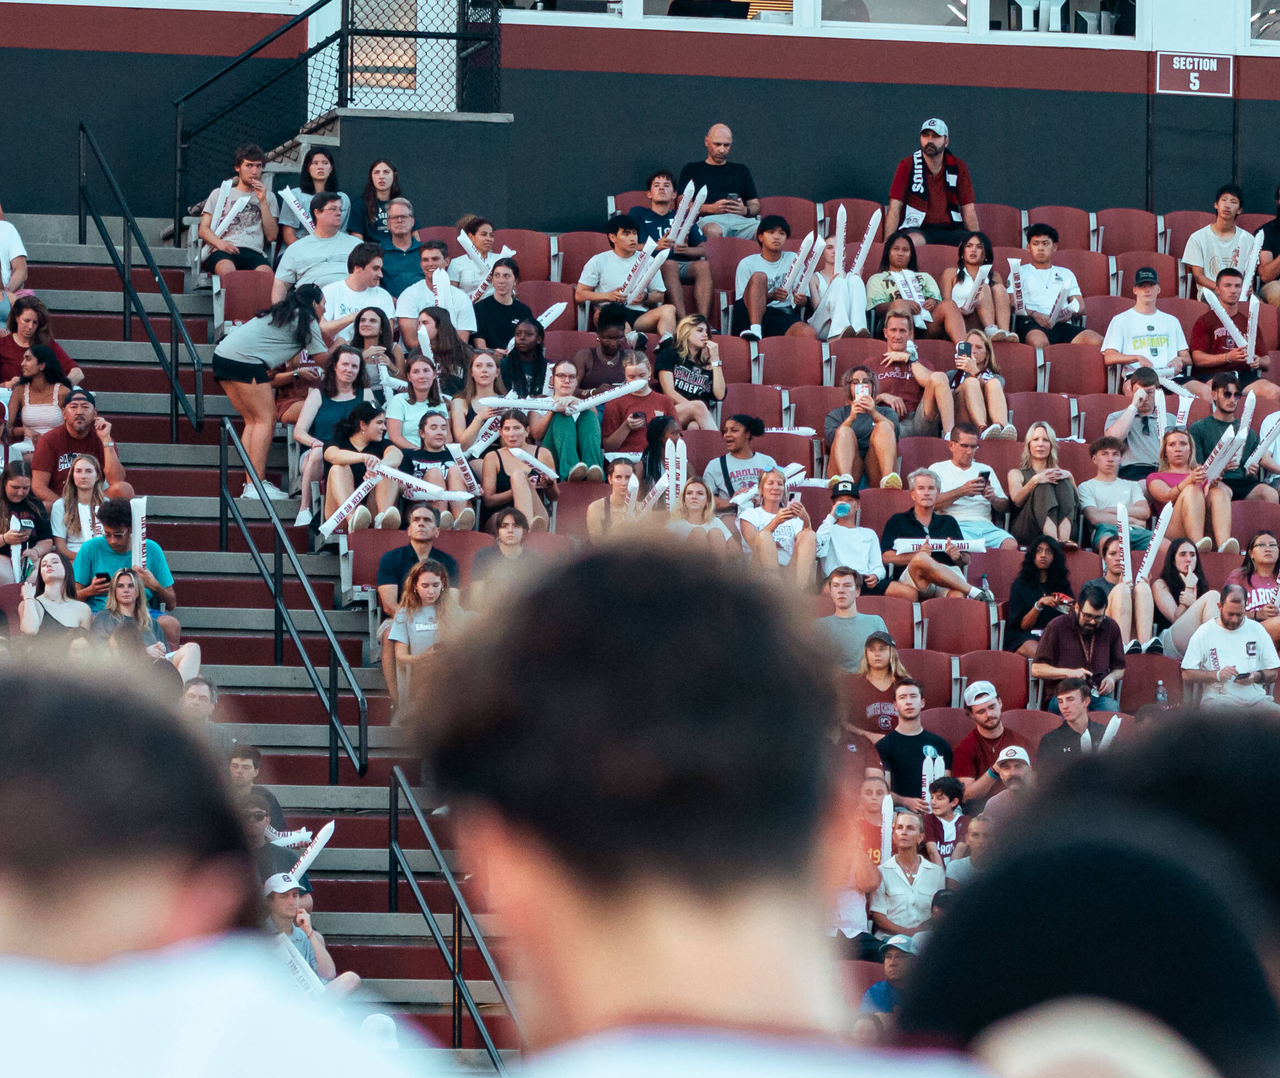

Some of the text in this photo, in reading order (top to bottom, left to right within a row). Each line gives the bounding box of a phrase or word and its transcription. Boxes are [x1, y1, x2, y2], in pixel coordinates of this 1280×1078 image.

[1173, 57, 1217, 71] SECTION
[1190, 72, 1200, 90] 5
[1177, 409, 1185, 424] FALL
[333, 481, 375, 525] LIVE ON NEXT FALL
[142, 532, 146, 541] ON
